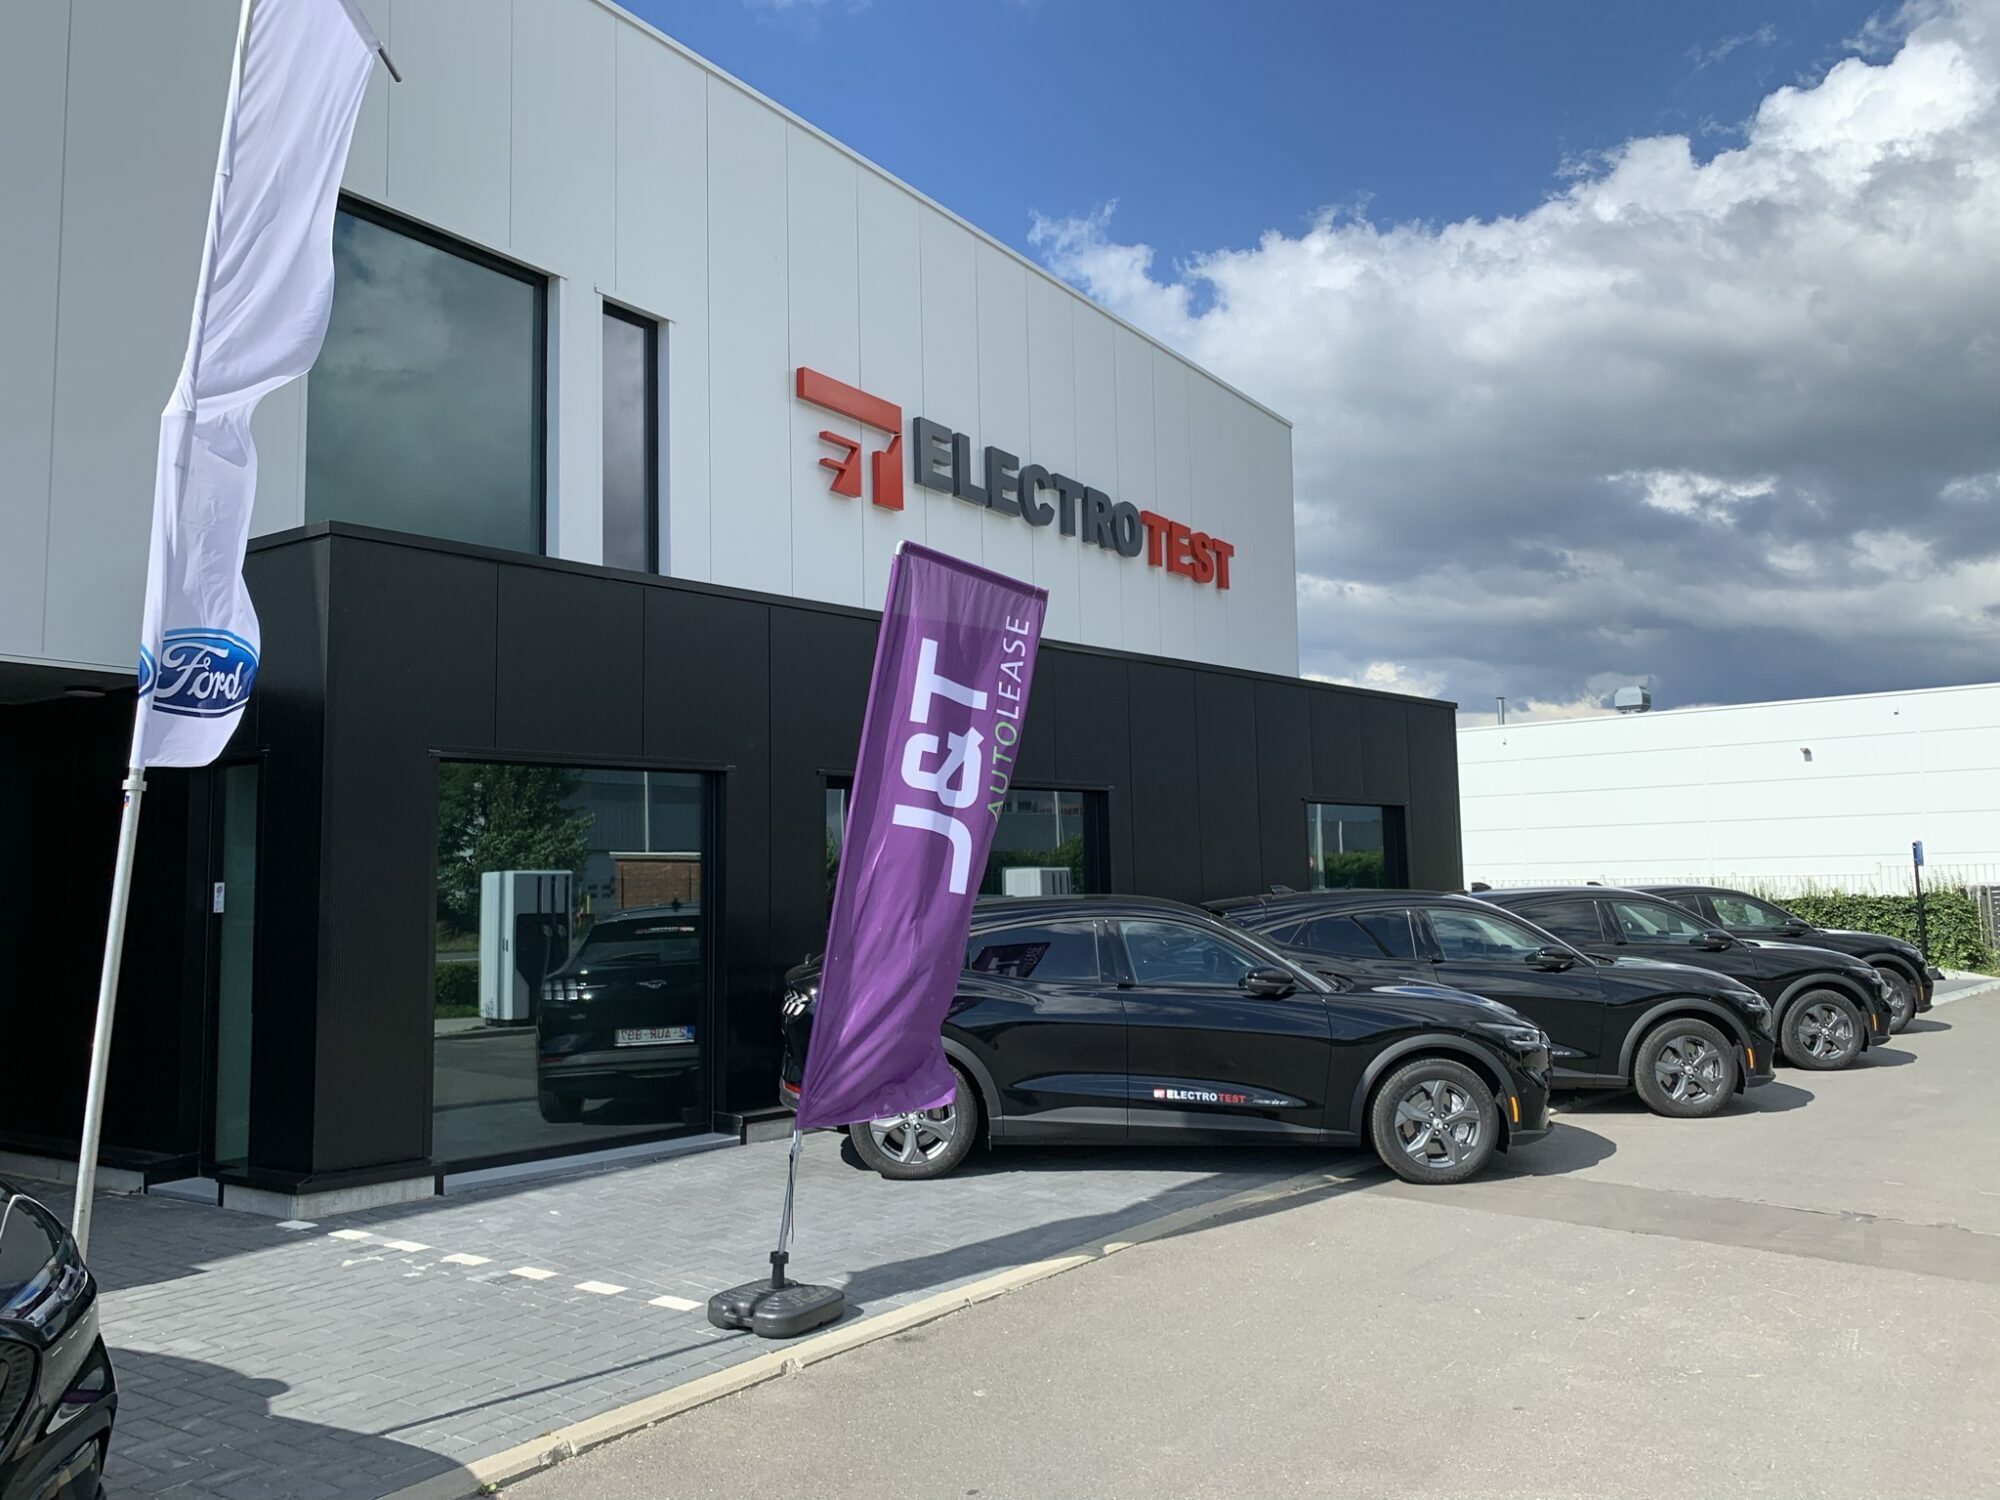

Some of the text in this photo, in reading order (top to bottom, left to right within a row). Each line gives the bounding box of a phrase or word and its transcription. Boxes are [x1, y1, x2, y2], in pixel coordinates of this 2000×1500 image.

[913, 416, 1234, 590] ELECTROTEST
[154, 642, 244, 700] Ford
[986, 615, 1030, 823] AUTOLEASE
[892, 637, 988, 895] J&T
[1166, 1089, 1246, 1103] ELECTROTEST
